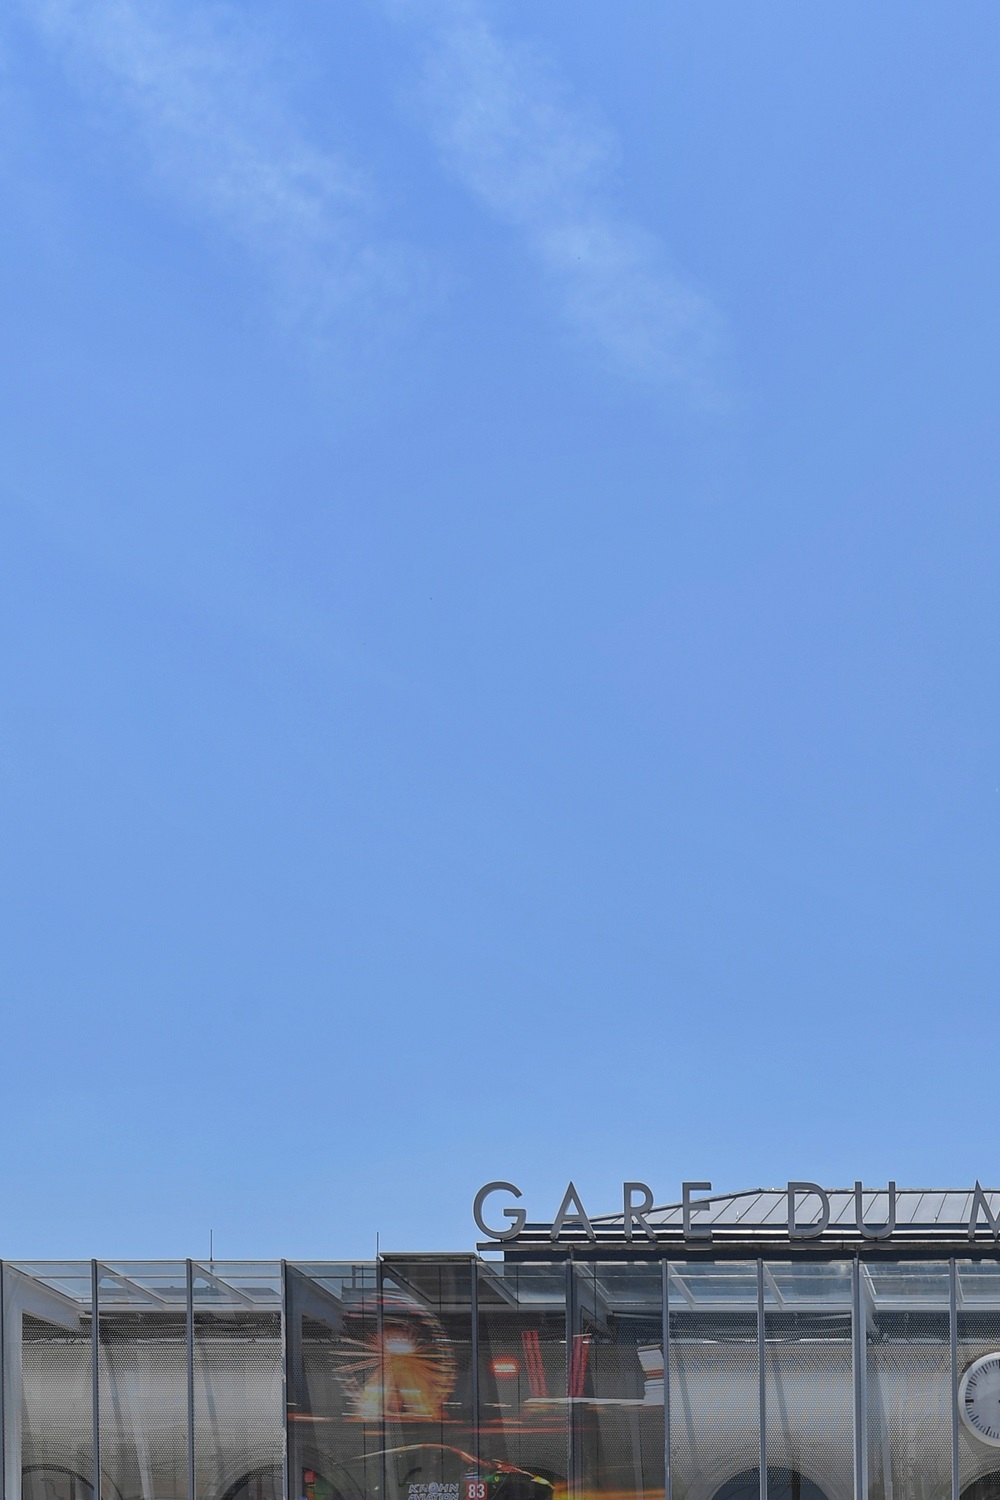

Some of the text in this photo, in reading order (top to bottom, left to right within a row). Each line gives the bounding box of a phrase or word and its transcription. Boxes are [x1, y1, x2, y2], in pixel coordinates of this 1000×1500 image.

[473, 1181, 712, 1240] GARE
[787, 1180, 896, 1240] DU
[468, 1483, 485, 1499] 83
